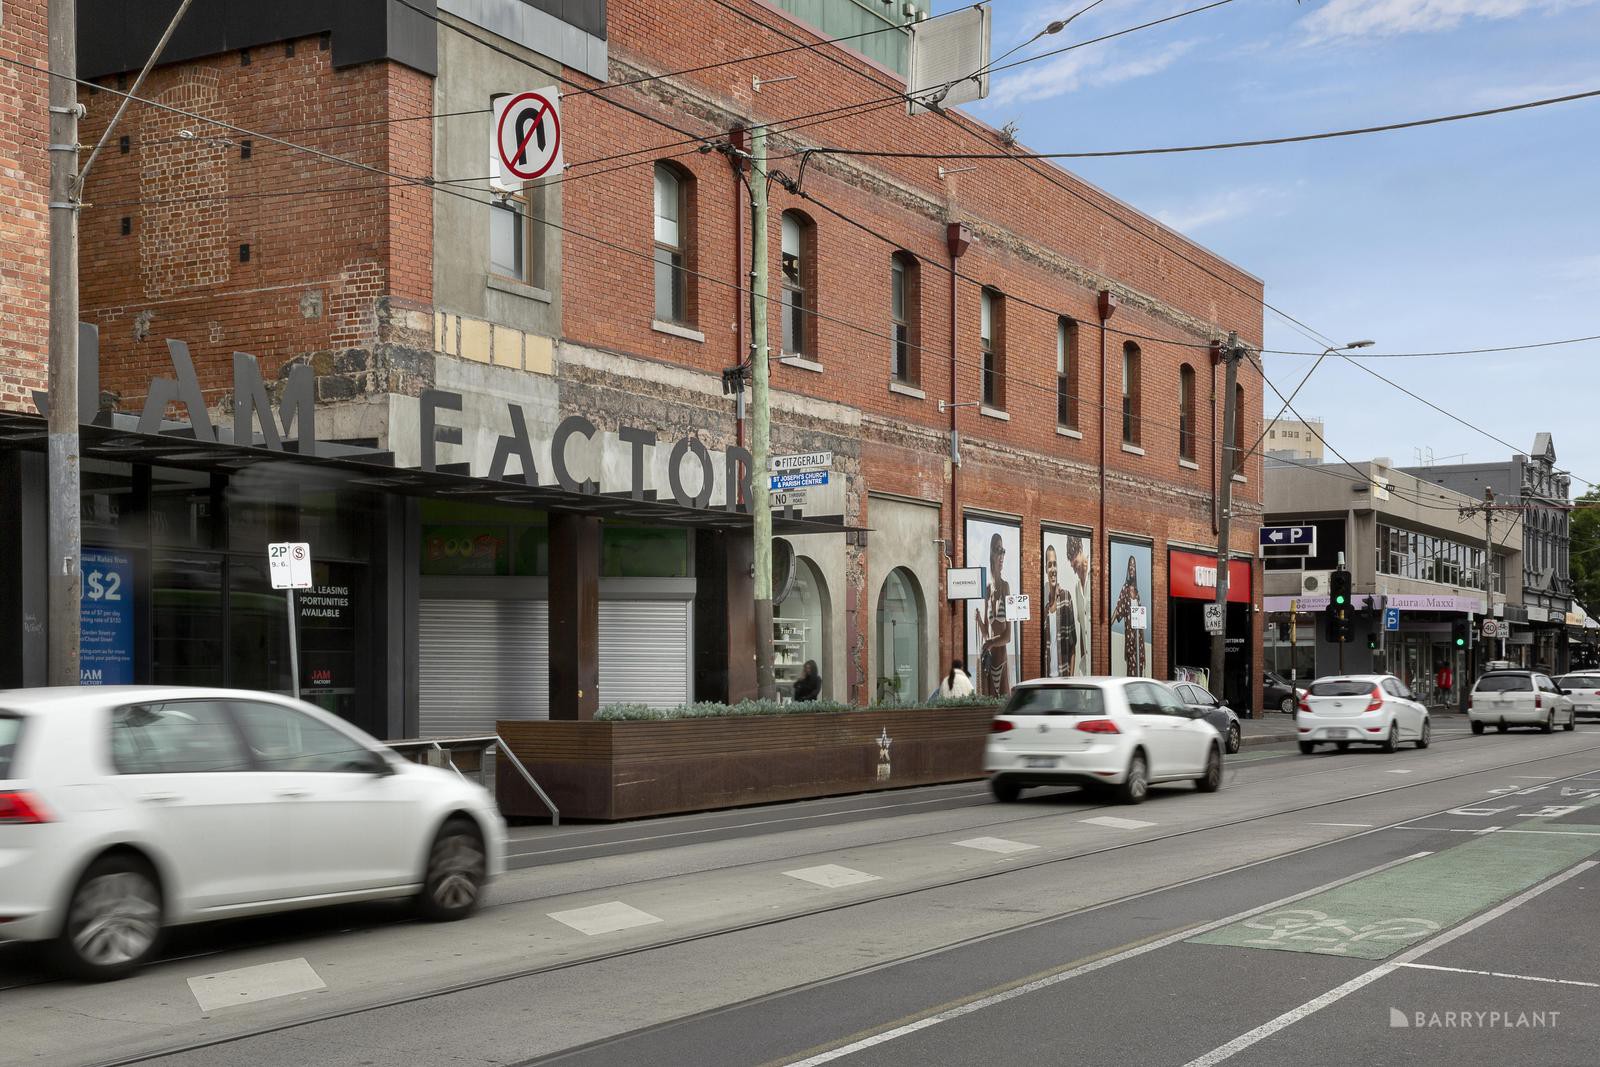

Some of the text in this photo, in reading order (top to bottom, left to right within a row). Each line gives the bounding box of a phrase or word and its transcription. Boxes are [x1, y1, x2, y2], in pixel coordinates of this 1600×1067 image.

[420, 388, 802, 520] FACTOR
[782, 455, 825, 467] FITZGERALD
[780, 474, 804, 482] JOSEPH'S
[801, 478, 823, 486] CENTRE
[775, 494, 786, 505] NO
[1290, 529, 1303, 544] P
[271, 546, 287, 558] 2P
[87, 569, 121, 601] $2
[318, 586, 349, 595] LEASING
[1392, 597, 1419, 607] Laura
[1426, 598, 1454, 607] Maxxi
[301, 609, 340, 617] AVAILABLE
[1206, 620, 1221, 628] LANE
[1387, 617, 1397, 628] P
[1485, 624, 1495, 632] 40
[311, 670, 331, 680] JAM
